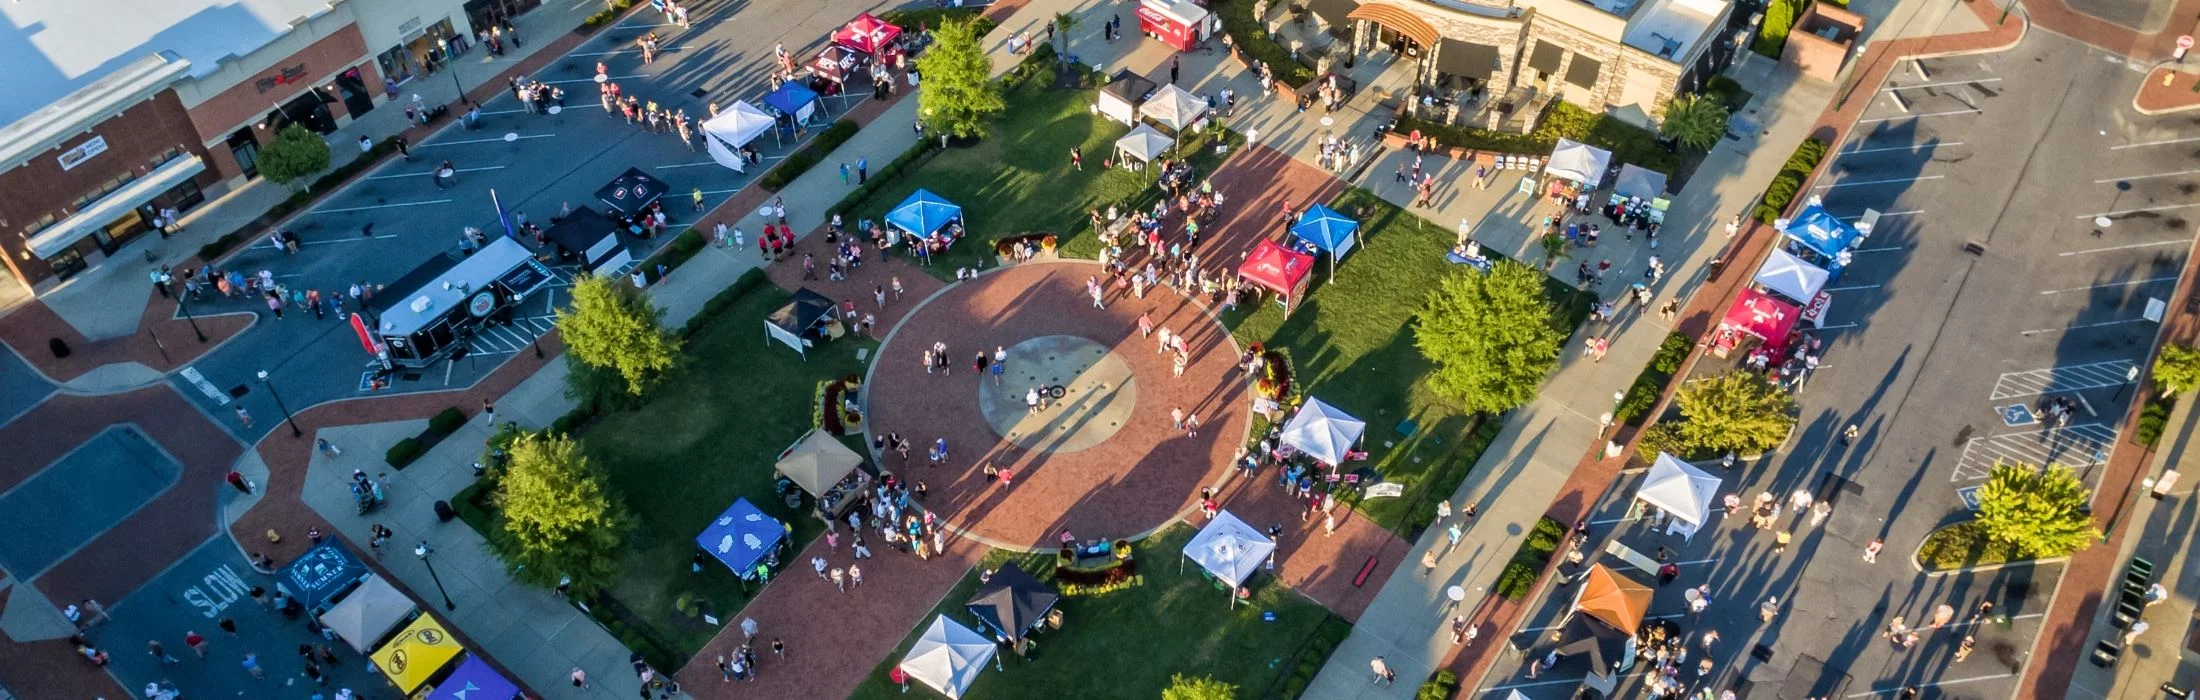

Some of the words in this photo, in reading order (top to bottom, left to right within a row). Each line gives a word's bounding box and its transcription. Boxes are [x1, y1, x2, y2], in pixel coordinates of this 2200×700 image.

[817, 57, 838, 69] UFC
[839, 53, 855, 70] UFC
[184, 564, 250, 618] SLOW
